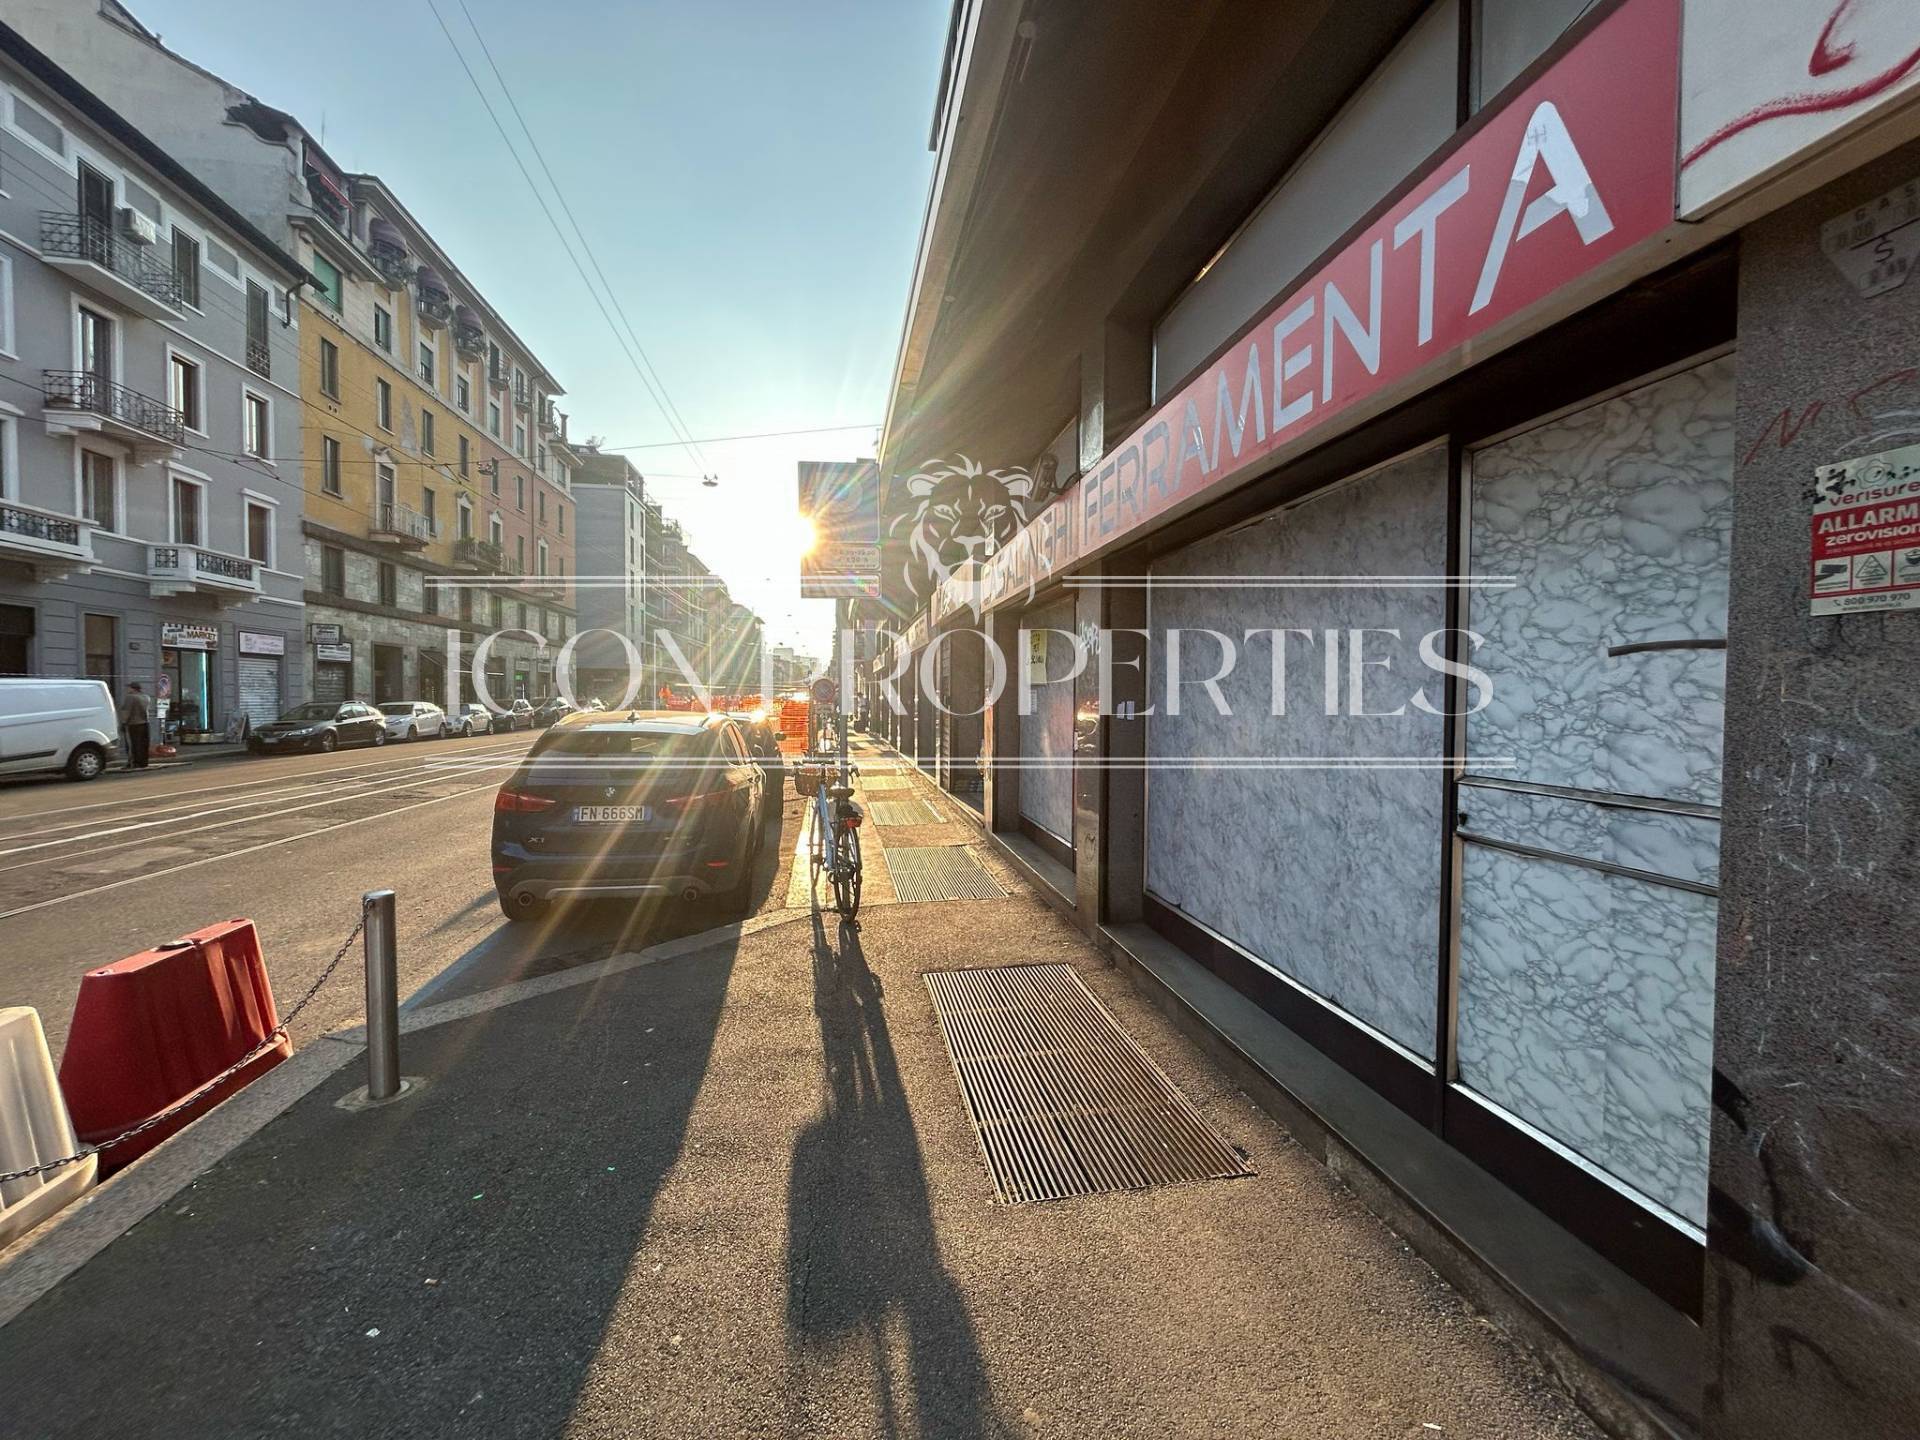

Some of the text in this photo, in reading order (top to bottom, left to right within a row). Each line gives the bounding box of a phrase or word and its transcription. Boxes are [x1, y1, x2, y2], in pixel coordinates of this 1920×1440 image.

[1083, 101, 1615, 547] FERRAMENTA
[1829, 481, 1920, 506] verisure
[1824, 522, 1920, 547] zerovision
[1867, 594, 1887, 603] 970
[1889, 592, 1911, 601] 970
[187, 630, 217, 640] MARKET
[580, 807, 598, 820] FN
